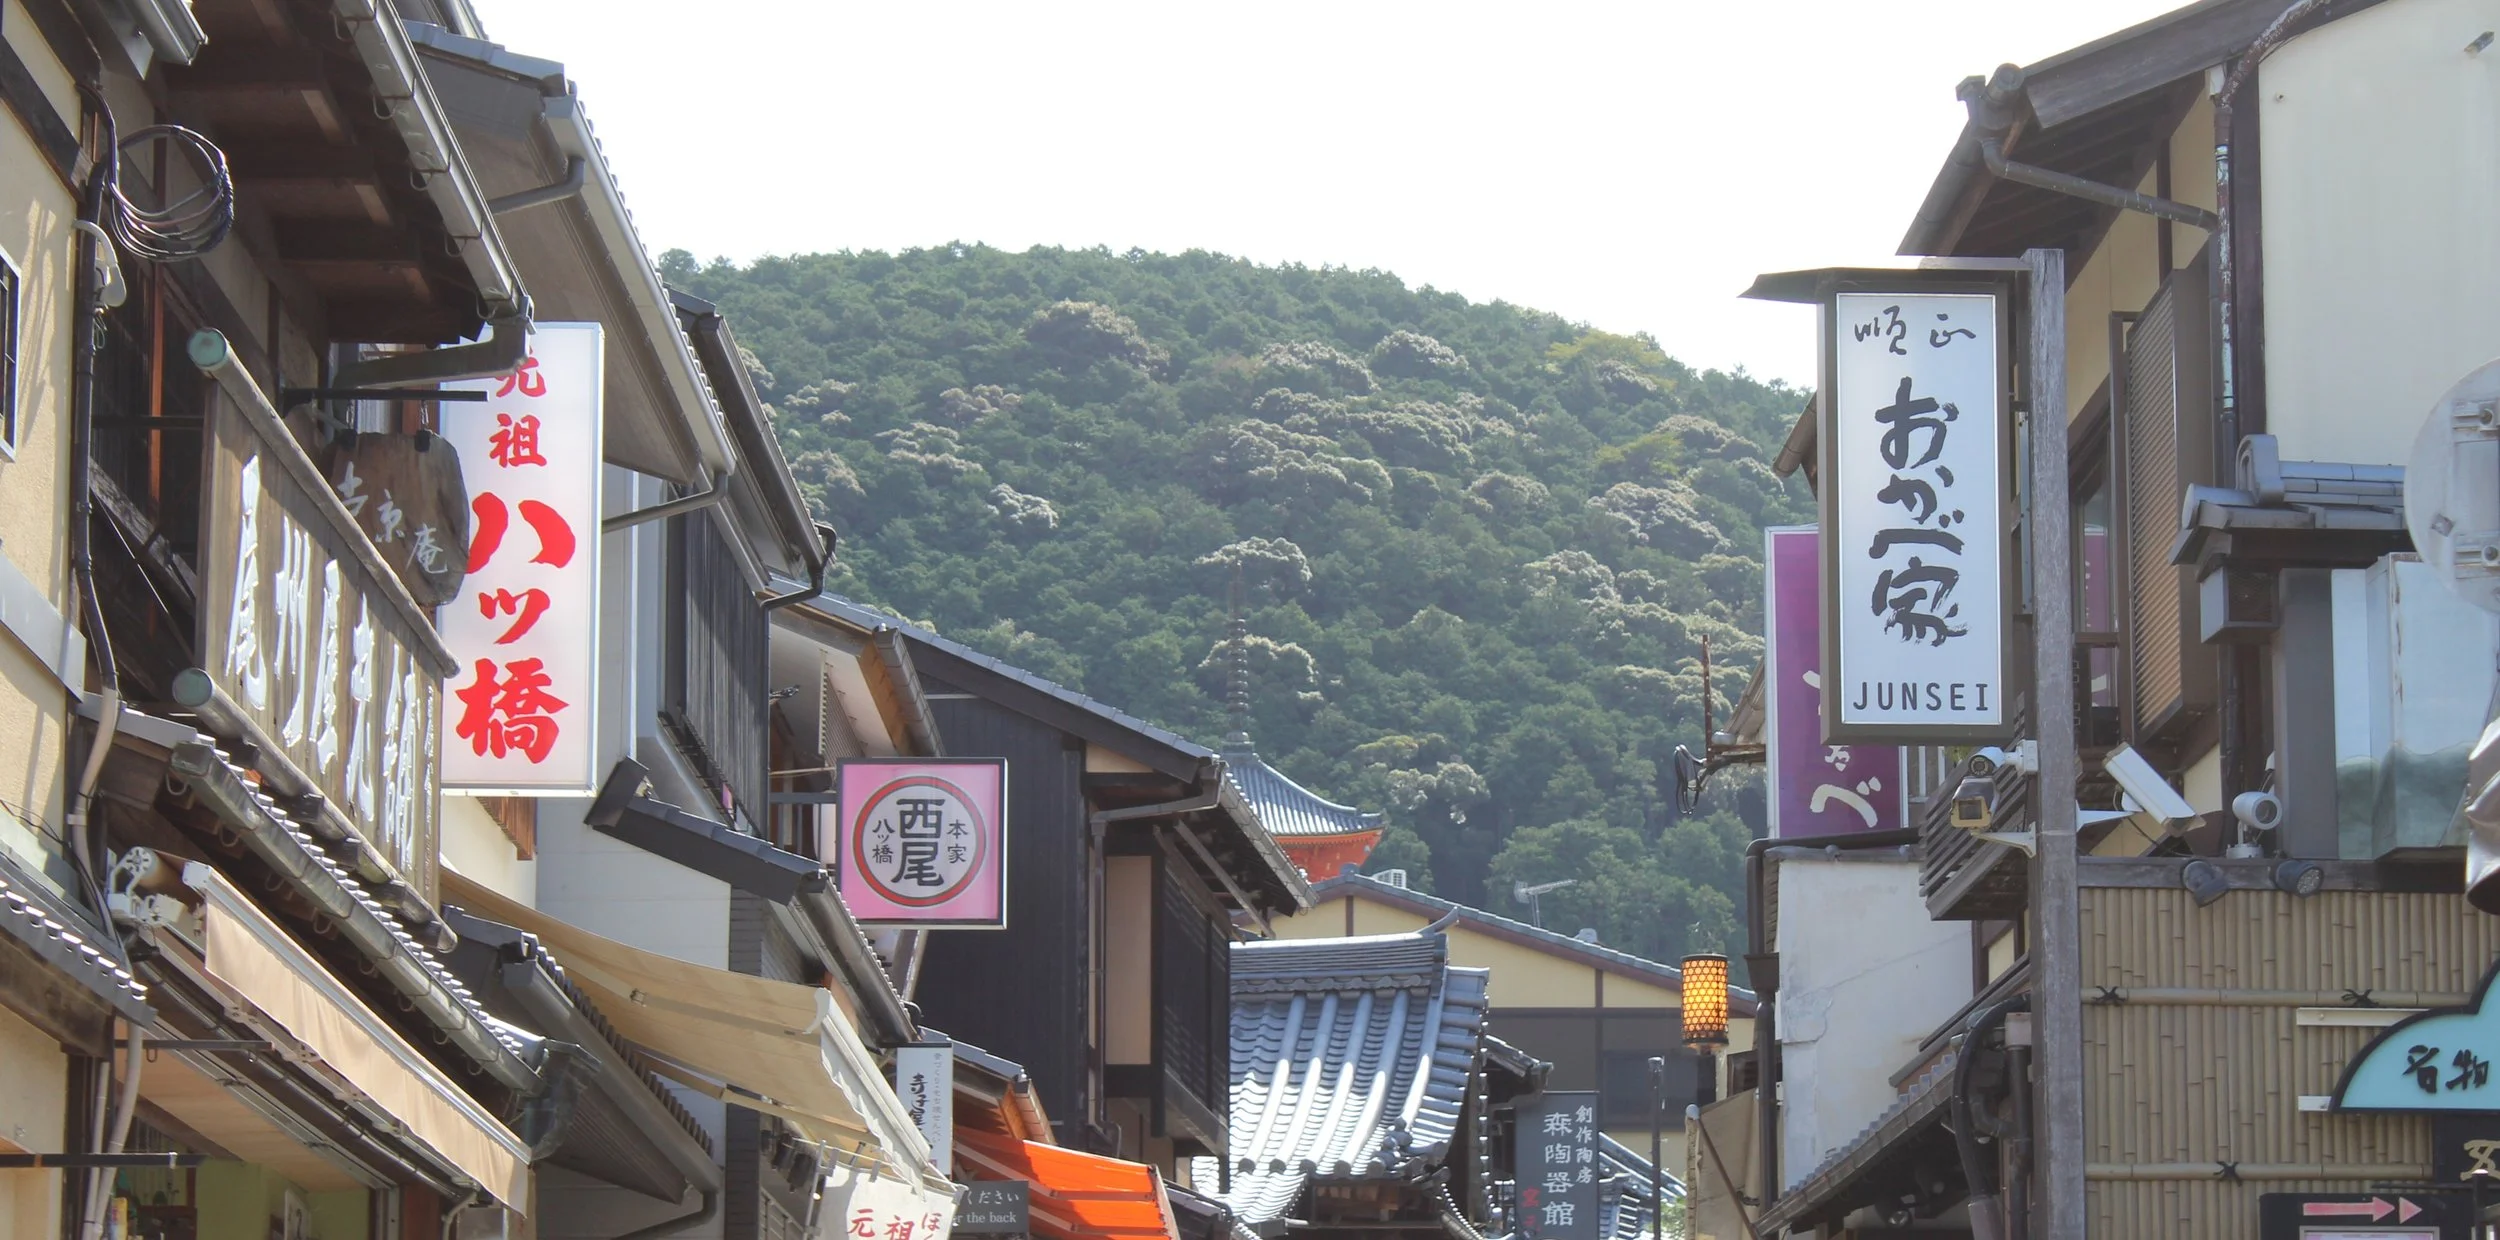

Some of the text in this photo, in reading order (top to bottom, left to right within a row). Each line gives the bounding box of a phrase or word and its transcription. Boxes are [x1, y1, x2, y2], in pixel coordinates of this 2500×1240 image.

[1868, 376, 1968, 648] おかべ家
[1853, 681, 1988, 711] JUNSEI
[890, 798, 945, 887] 西尾
[946, 819, 969, 864] 本家
[2402, 1044, 2490, 1095] 名物
[1542, 1112, 1575, 1227] 森陶器館
[1575, 1105, 1594, 1184] 創作陶房
[966, 1211, 986, 1224] the
[989, 1211, 1018, 1224] back
